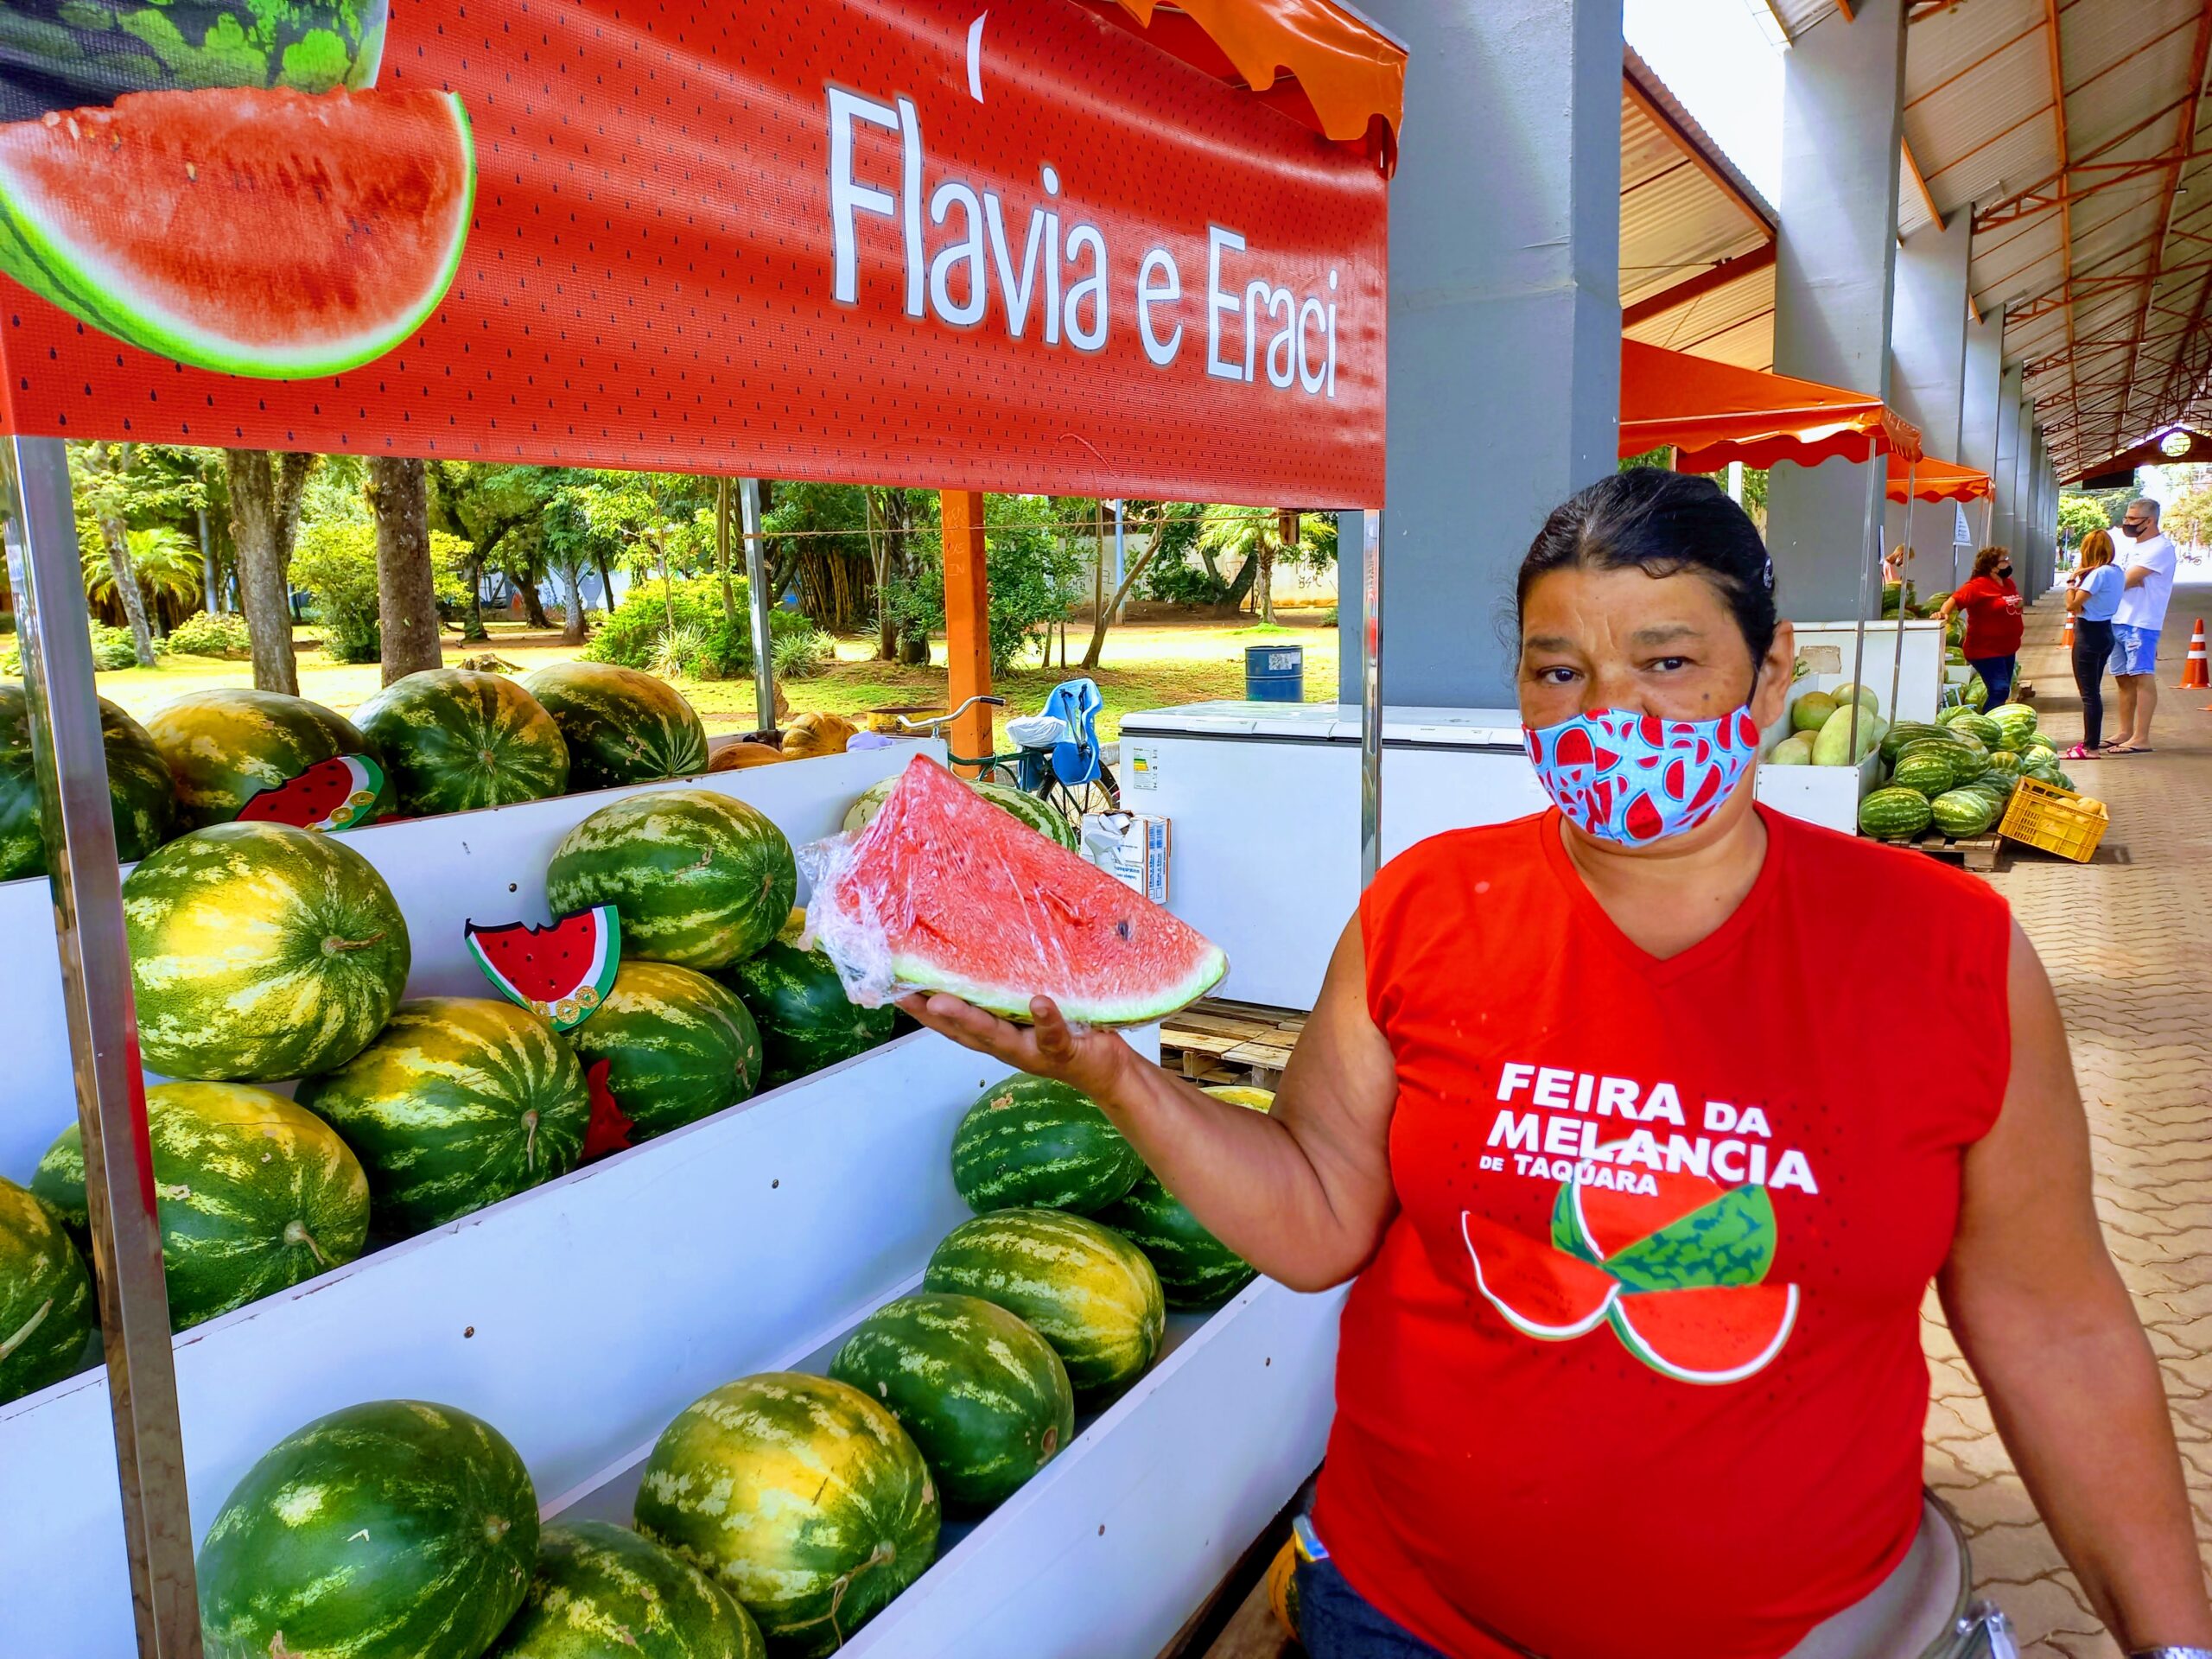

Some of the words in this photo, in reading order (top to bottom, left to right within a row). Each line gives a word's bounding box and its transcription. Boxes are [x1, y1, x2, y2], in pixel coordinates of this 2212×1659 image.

[827, 86, 1109, 351] Flavia
[1136, 247, 1183, 365] e
[1206, 226, 1337, 397] Eraci
[1496, 1061, 1686, 1127] FEIRA
[1703, 1100, 1773, 1138] DA
[1478, 1155, 1505, 1172] DE
[1486, 1109, 1820, 1195] MELANCIA
